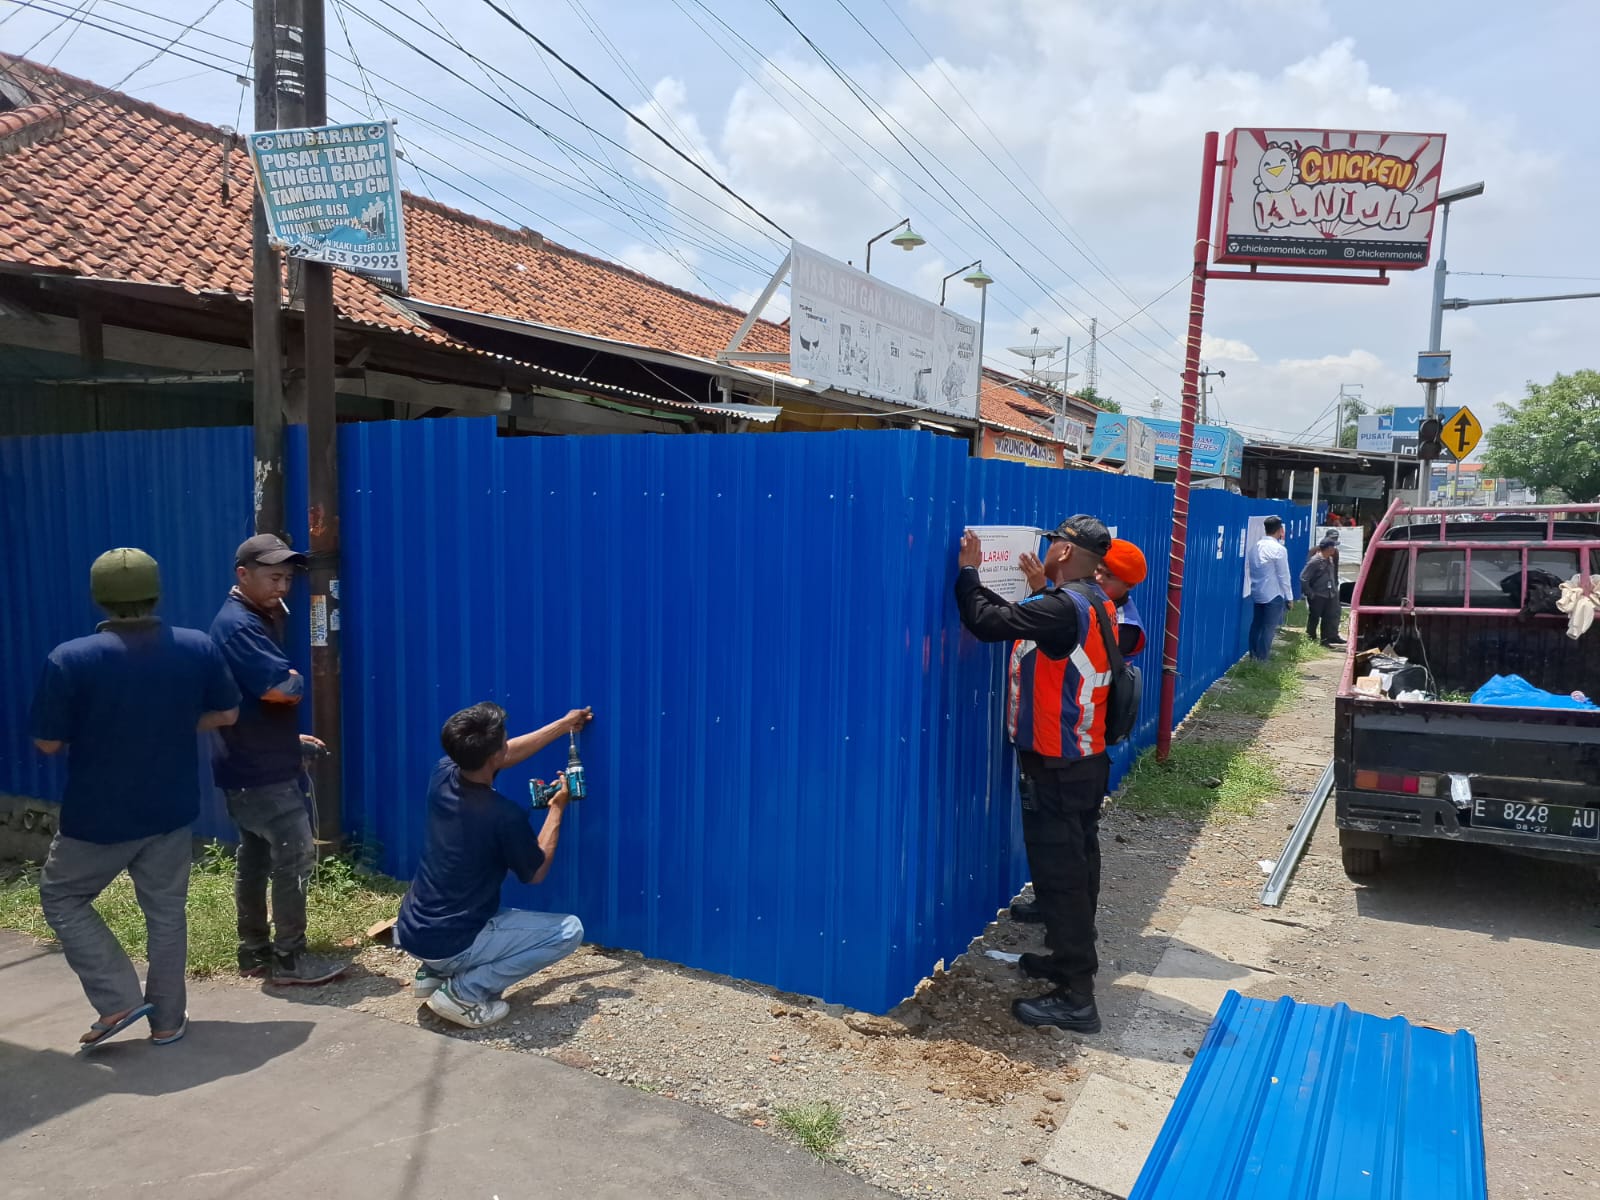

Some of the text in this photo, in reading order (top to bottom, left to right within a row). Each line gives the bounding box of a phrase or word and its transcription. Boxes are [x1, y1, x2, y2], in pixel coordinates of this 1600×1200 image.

[276, 127, 366, 149] MUBARAK
[262, 143, 386, 170] PUSAT TERAPI
[266, 159, 387, 188] TINGGI BADAN
[1300, 151, 1414, 189] CHICKEN
[270, 183, 338, 206] TAMBAH
[365, 176, 390, 194] CM
[276, 203, 349, 222] LANGSUNG BISA
[352, 254, 399, 269] 99993
[1240, 244, 1328, 256] chickenmontok.com
[1356, 249, 1424, 261] chickenmontok
[859, 285, 882, 315] GAK
[1361, 432, 1386, 441] PUSAT
[1474, 800, 1595, 829] E 8248 AU
